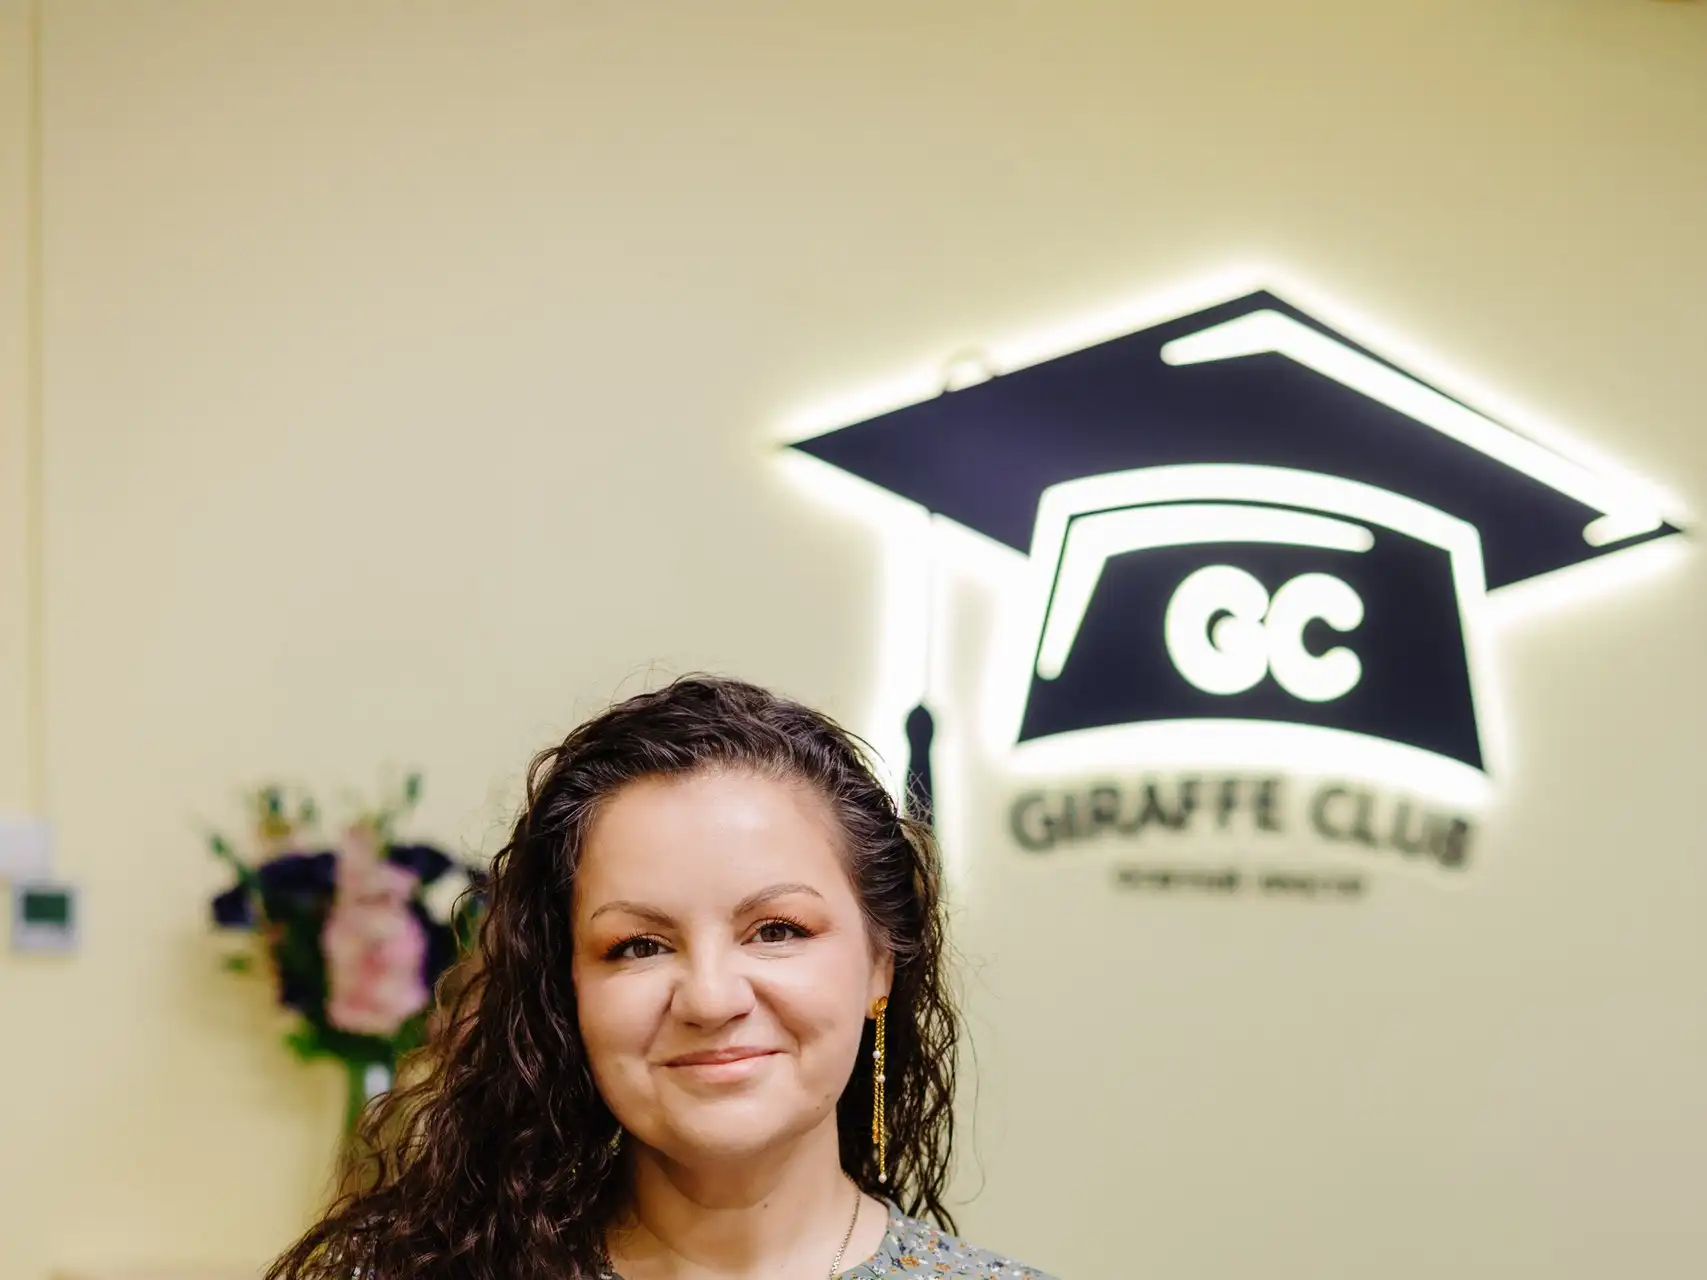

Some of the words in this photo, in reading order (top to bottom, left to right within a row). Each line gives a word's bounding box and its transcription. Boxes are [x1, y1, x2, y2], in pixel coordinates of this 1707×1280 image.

[1165, 565, 1365, 702] GC
[1010, 776, 1284, 851] GIRAFFE
[1311, 784, 1473, 868] CLUB
